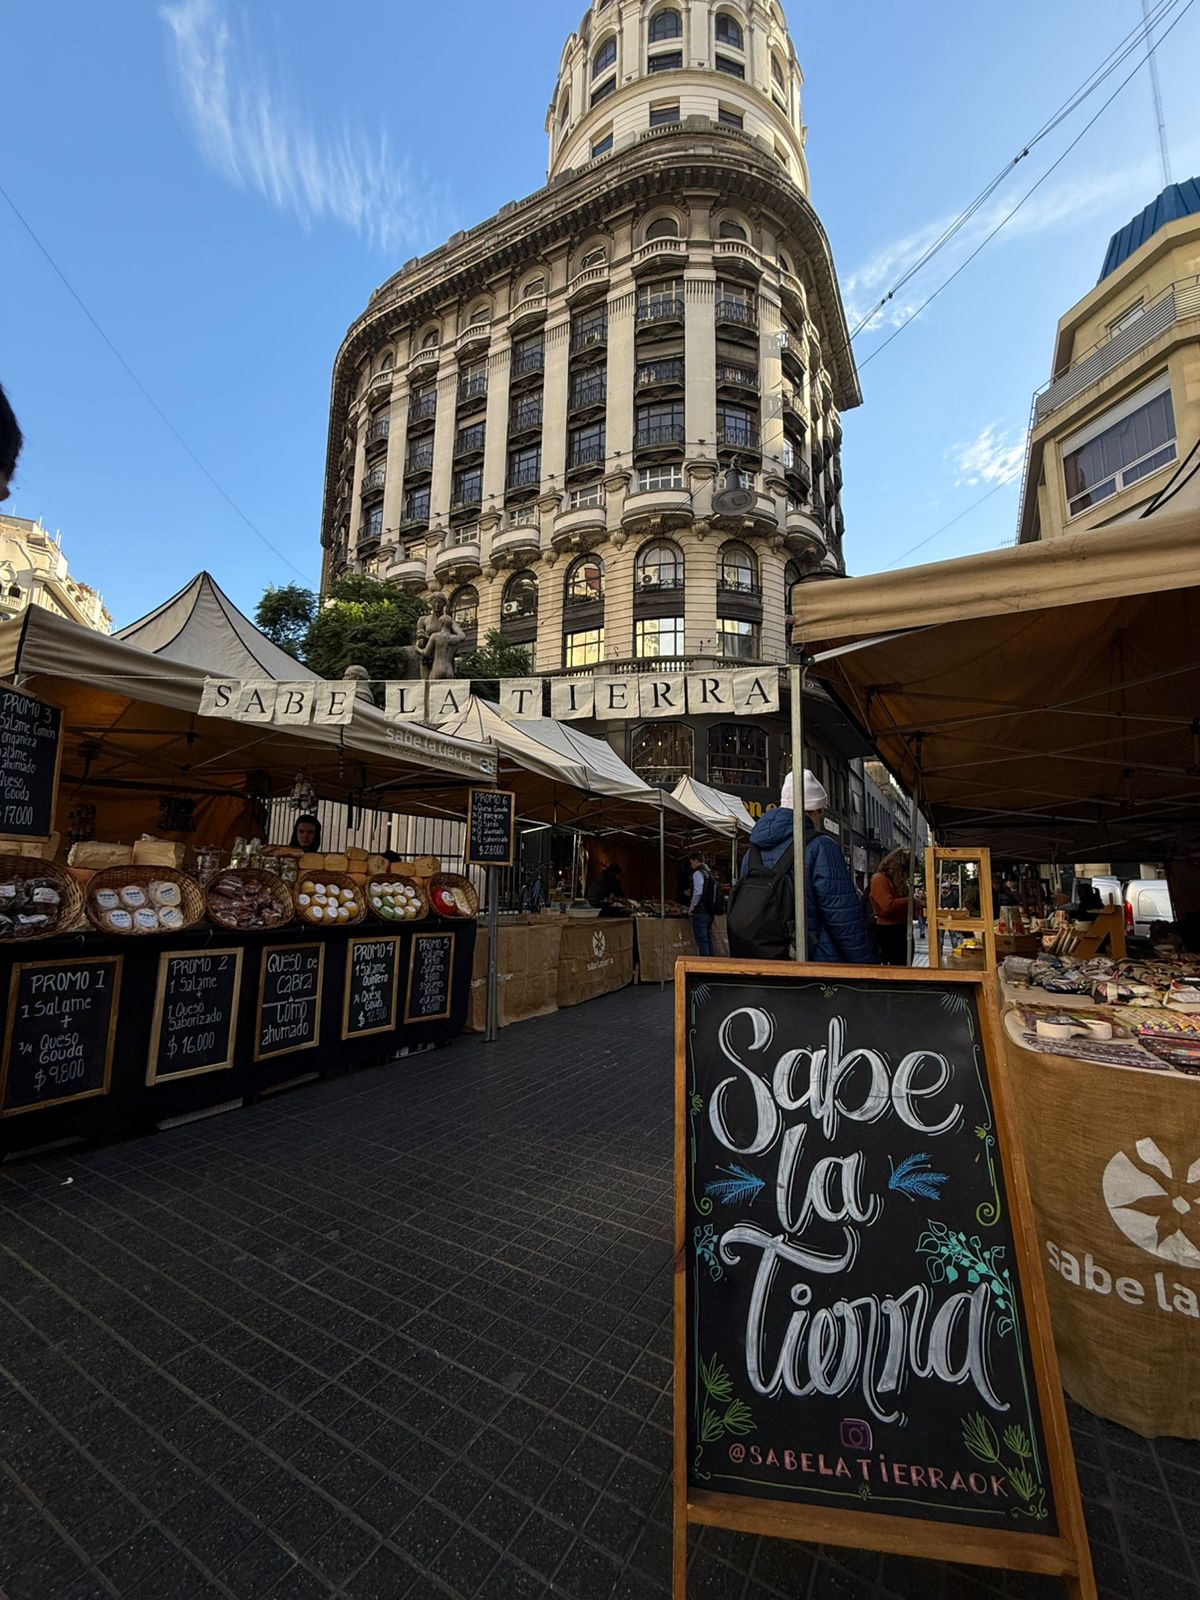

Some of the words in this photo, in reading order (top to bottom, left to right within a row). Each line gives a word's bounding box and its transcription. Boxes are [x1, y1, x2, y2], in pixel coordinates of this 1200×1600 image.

[3, 693, 40, 718] PROMO
[43, 707, 52, 724] 3
[214, 684, 348, 716] SABE
[397, 688, 461, 714] LA
[511, 677, 772, 714] TIERRA
[354, 943, 386, 962] PROMO
[386, 942, 394, 957] 4
[171, 958, 211, 975] PROMO
[217, 955, 229, 971] 2
[31, 972, 90, 993] PROMO
[95, 970, 105, 988] 1
[170, 980, 175, 994] 1
[22, 1005, 30, 1019] 1
[34, 996, 92, 1017] Salame
[40, 1033, 79, 1051] Queso
[261, 1021, 310, 1047] ahumado
[39, 1045, 83, 1064] Gouda
[708, 1006, 965, 1157] Sabe
[775, 1122, 885, 1236] la
[1045, 1240, 1146, 1305] sabe
[1154, 1271, 1200, 1318] la
[718, 1219, 1011, 1427] Tierra
